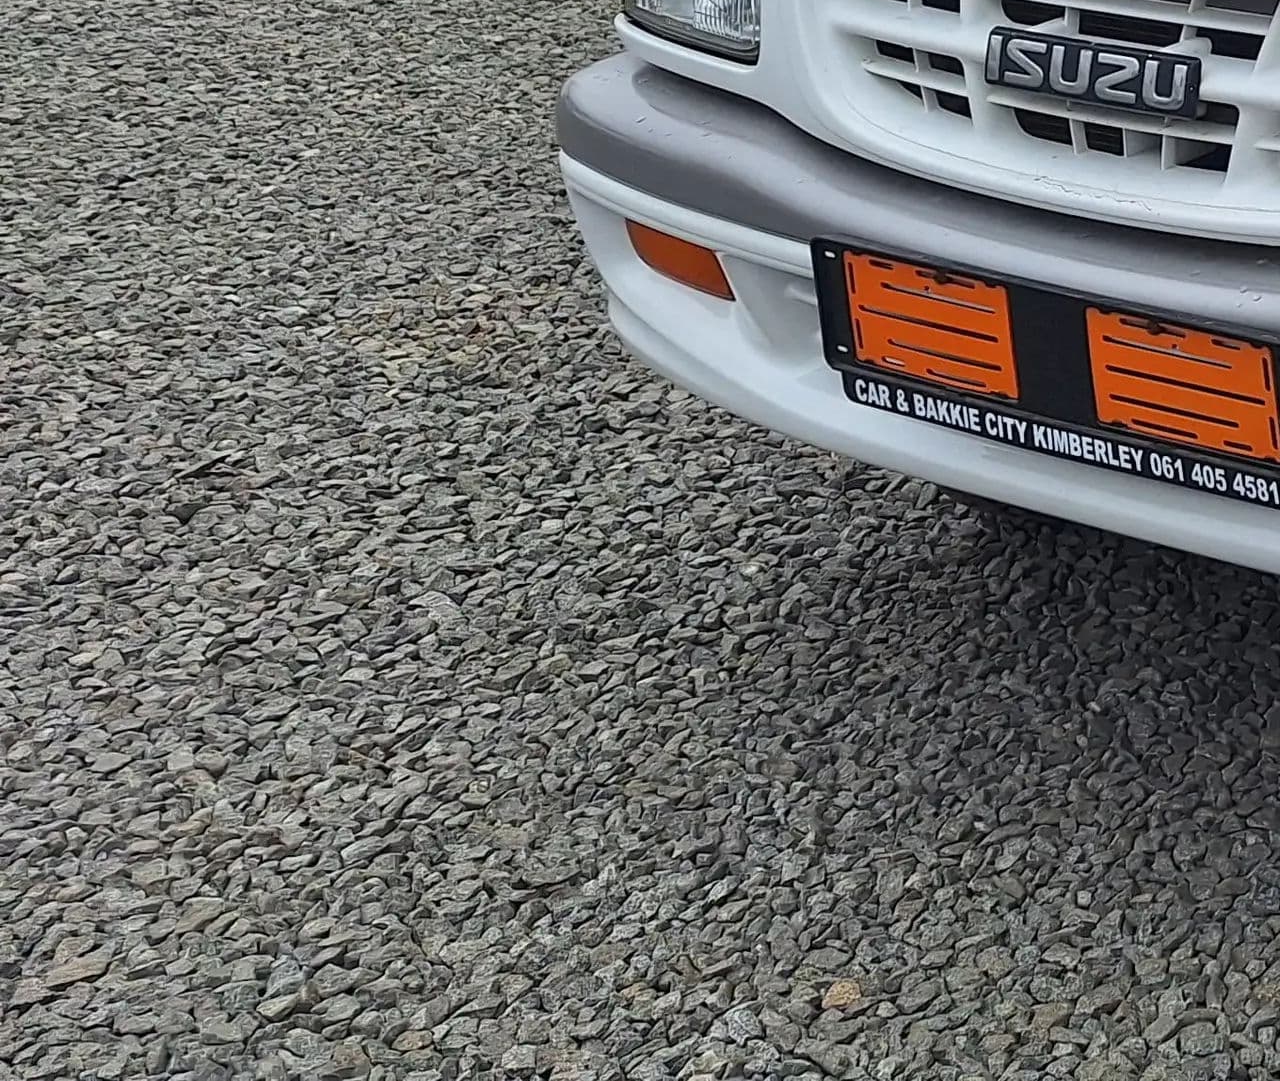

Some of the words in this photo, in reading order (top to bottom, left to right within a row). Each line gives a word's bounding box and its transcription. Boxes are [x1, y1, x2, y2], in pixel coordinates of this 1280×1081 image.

[985, 34, 1188, 111] ISUZU
[855, 379, 891, 409] CAR
[896, 388, 910, 412] &
[914, 394, 981, 432] BAKKIE
[985, 412, 1027, 445] CITY
[1032, 423, 1143, 472] KIMBERLEY
[1150, 452, 1185, 482] 061
[1191, 463, 1227, 492] 405
[1232, 473, 1280, 505] 4581
